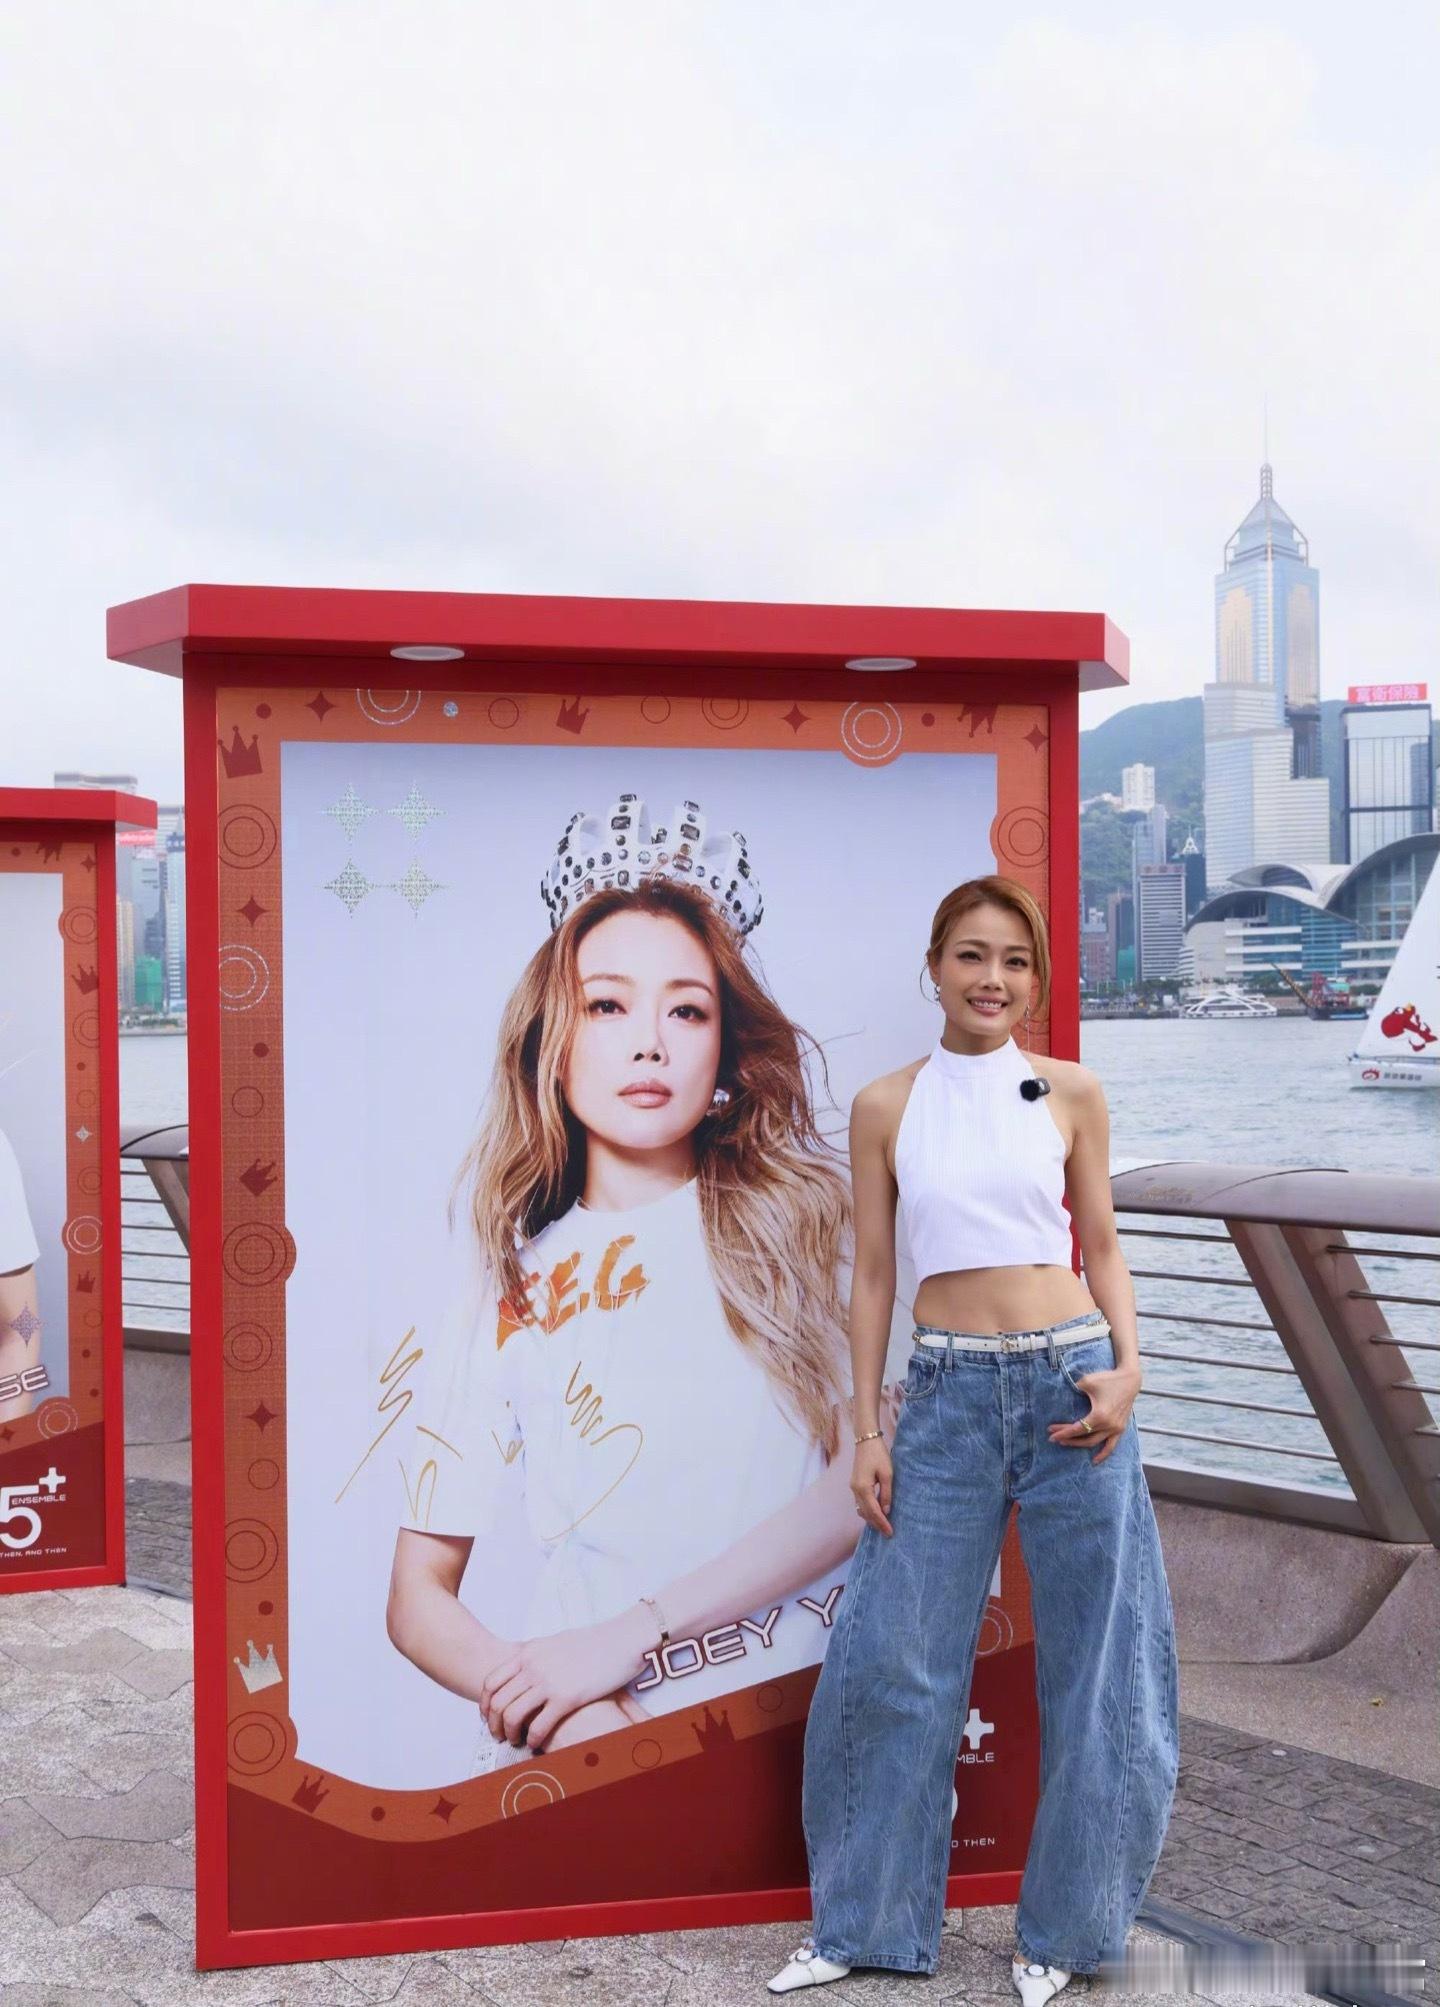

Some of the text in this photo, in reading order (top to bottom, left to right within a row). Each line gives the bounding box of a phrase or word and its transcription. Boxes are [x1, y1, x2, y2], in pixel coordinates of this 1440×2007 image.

[11, 1494, 67, 1506] ENSEMBLE
[635, 1605, 784, 1693] JOEY
[963, 1837, 995, 1847] THEN
